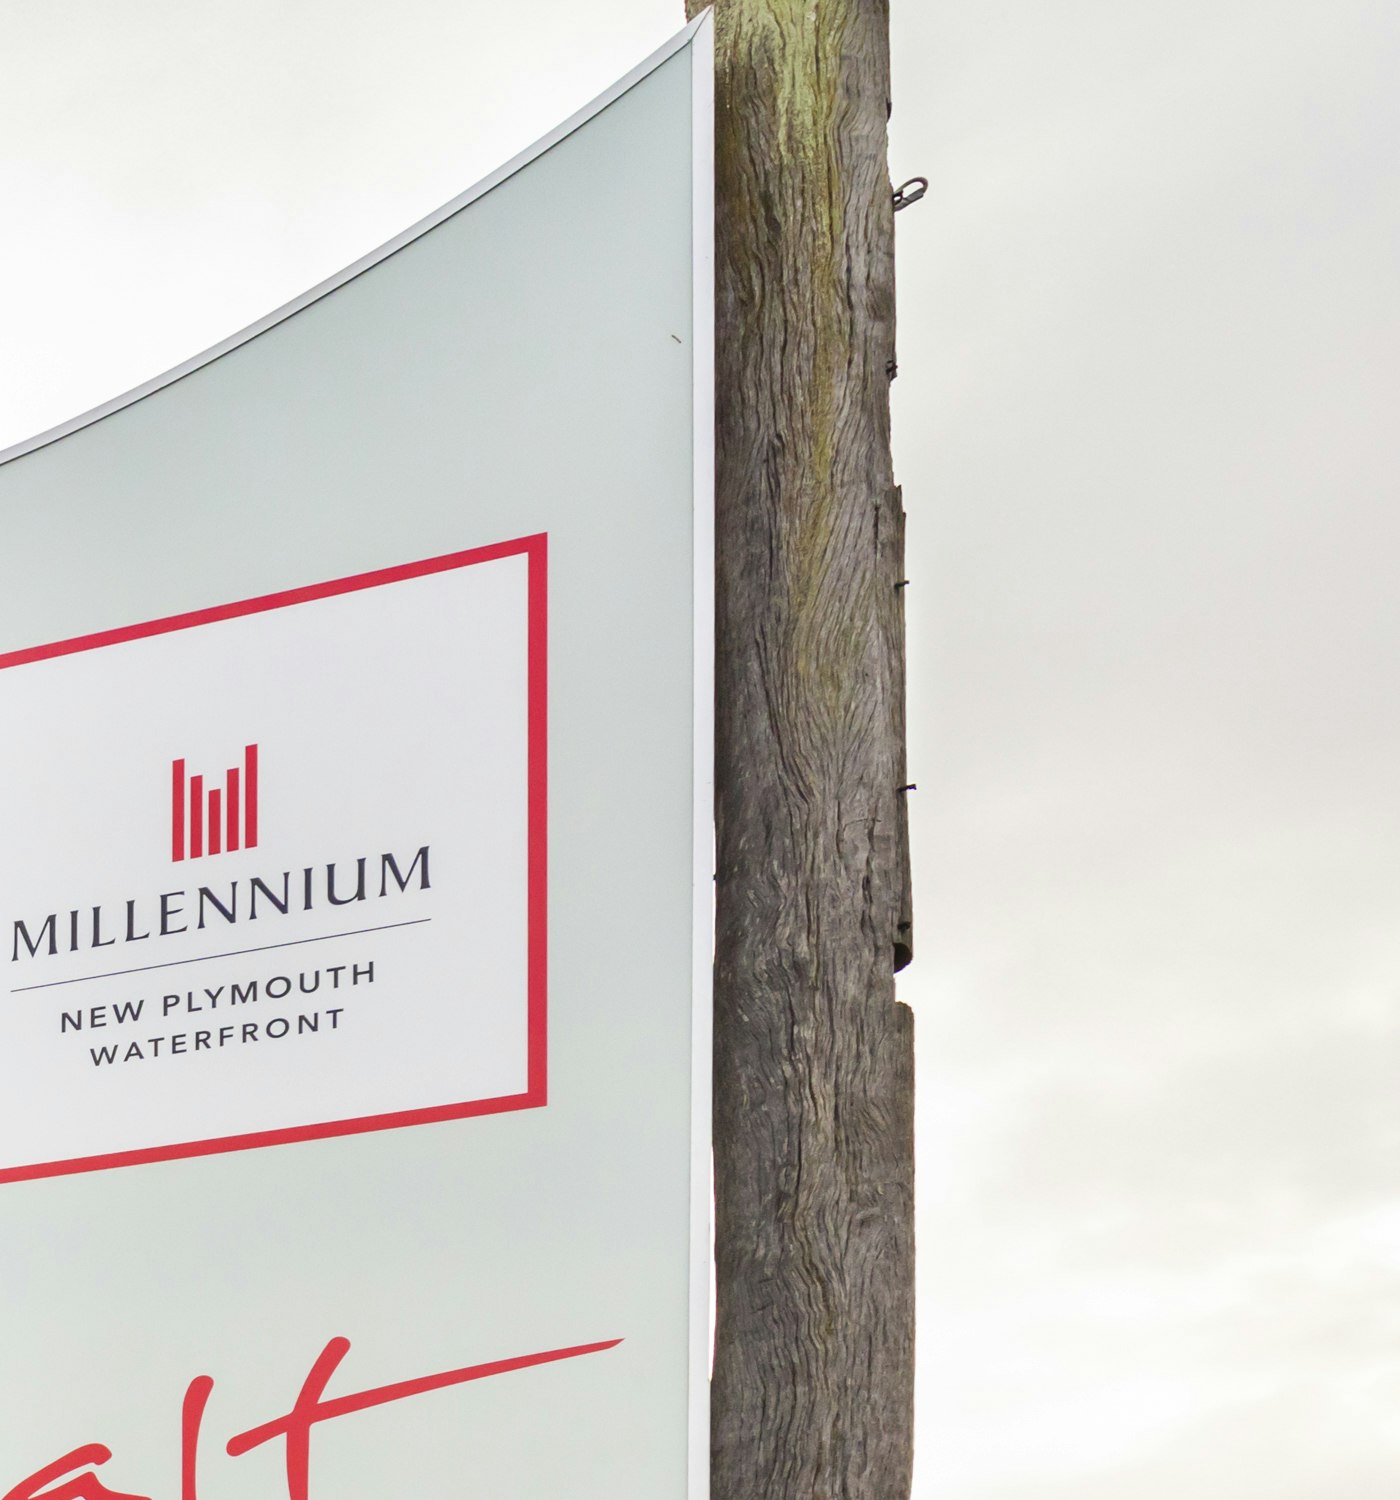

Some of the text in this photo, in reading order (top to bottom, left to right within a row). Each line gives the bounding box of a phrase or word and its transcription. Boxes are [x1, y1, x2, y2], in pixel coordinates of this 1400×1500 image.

[10, 845, 432, 963] MILLENNIUM
[60, 960, 375, 1034] NEW PLYMOUTH
[89, 1008, 345, 1067] WATERFRONT
